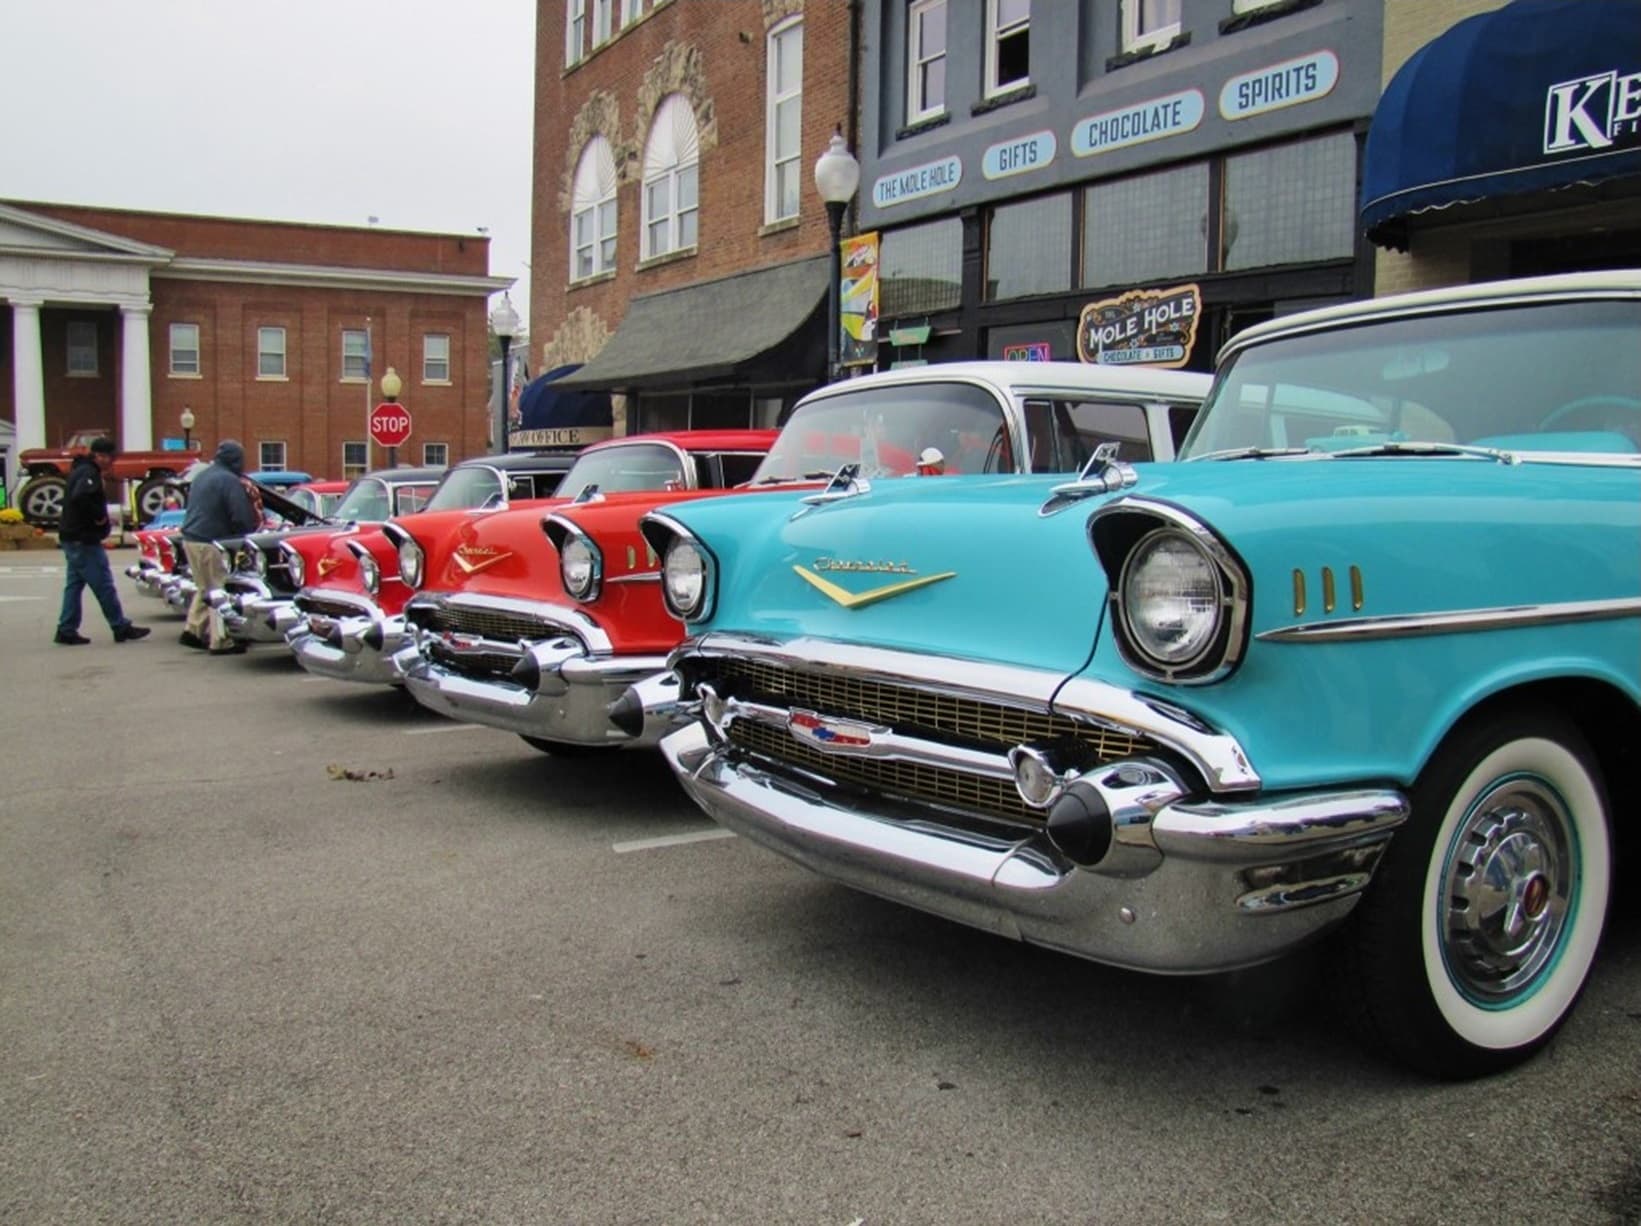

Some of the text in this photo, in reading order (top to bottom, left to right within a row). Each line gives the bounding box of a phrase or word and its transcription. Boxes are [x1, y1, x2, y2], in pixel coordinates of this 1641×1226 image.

[1238, 62, 1317, 110] SPIRITS
[1089, 100, 1182, 147] CHOCOLATE
[999, 140, 1038, 171] GIFTS
[880, 161, 955, 201] THE MOLE HOLE
[1089, 297, 1195, 353] MOLE HOLE
[1103, 347, 1175, 362] CHOCOLATE GIFTS
[372, 416, 409, 433] STOP
[531, 429, 580, 443] OFFICE
